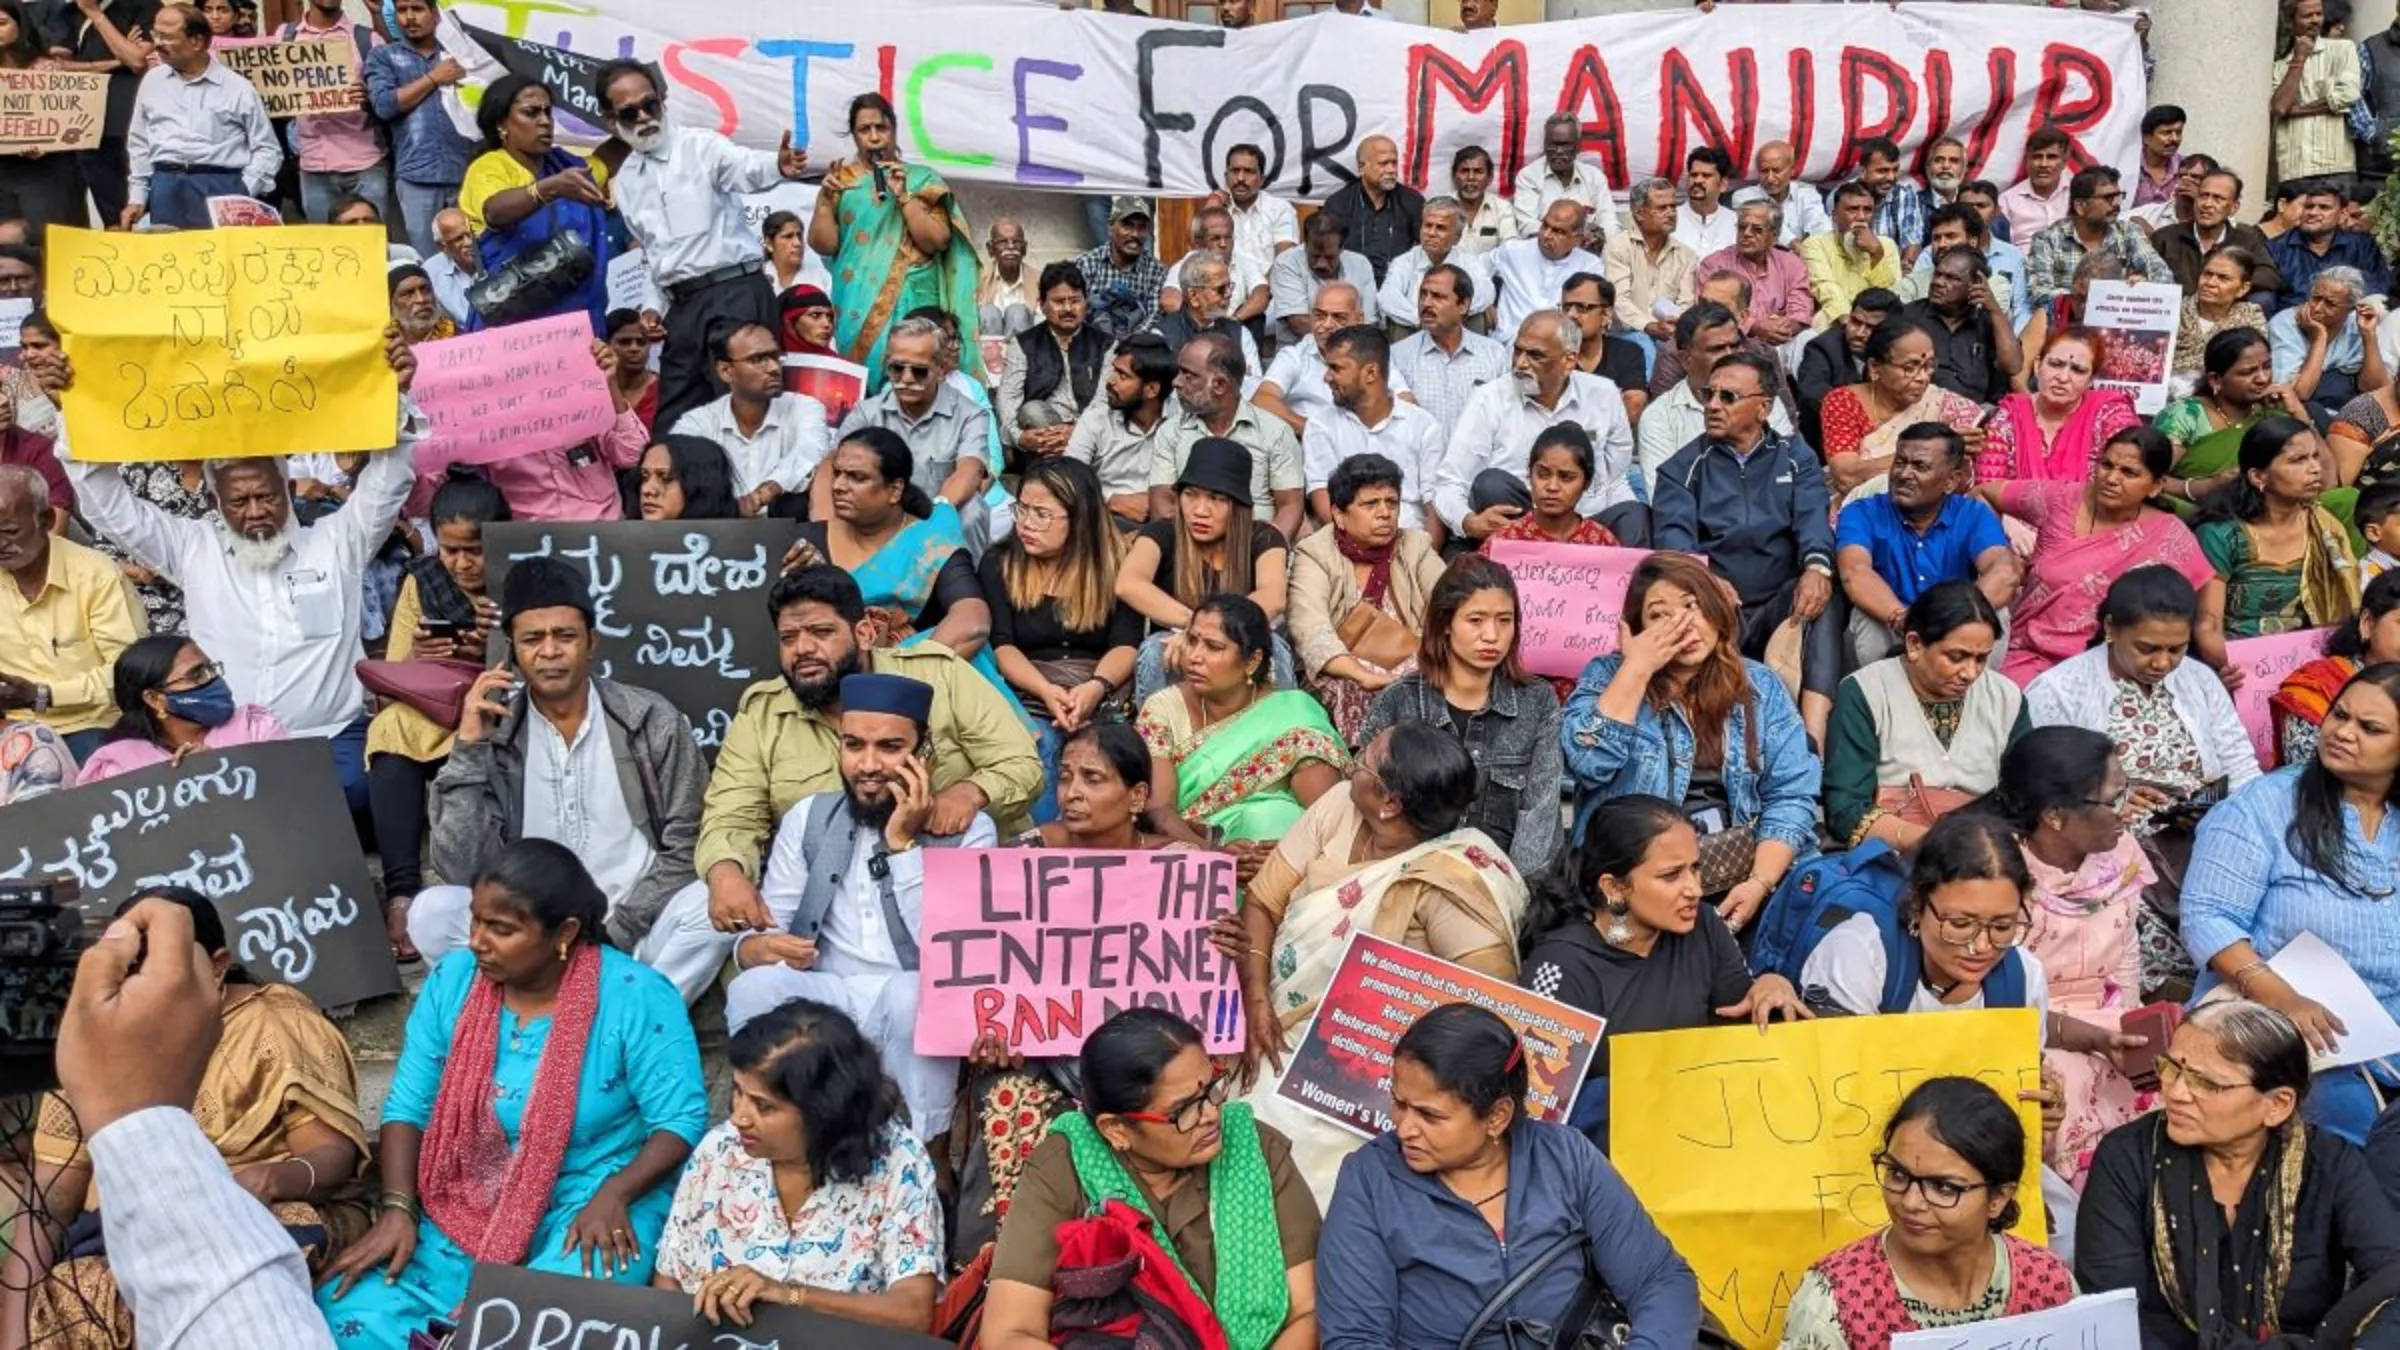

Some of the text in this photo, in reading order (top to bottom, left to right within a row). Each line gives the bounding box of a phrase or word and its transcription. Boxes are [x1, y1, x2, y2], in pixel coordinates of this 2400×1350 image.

[49, 74, 99, 91] BODIES
[220, 43, 327, 68] THERE CAN
[262, 69, 289, 88] NO
[293, 65, 348, 88] PEACE
[4, 93, 83, 111] NOT YOUR
[306, 91, 352, 109] JUSTIC
[542, 63, 603, 117] Man
[1137, 29, 1359, 193] FOR
[1402, 39, 2112, 197] MANIPUR
[168, 287, 302, 360] ನ್ಯಾಯ
[650, 532, 767, 596] ದೇಹ
[636, 616, 751, 679] ನಿಮ್ಮ
[979, 853, 1233, 924] LIFT THE
[235, 884, 359, 983] ನ್ಯಾಯ
[1360, 975, 1410, 1002] promotes
[1360, 950, 1377, 966] We
[1378, 956, 1422, 982] demand
[1421, 972, 1447, 991] that
[1446, 980, 1464, 997] the
[1465, 987, 1495, 1011] State
[1497, 1001, 1561, 1033] safeguards
[1562, 1024, 1585, 1043] and
[973, 988, 1083, 1047] BAN
[1332, 1008, 1389, 1041] Restorative
[1301, 1079, 1371, 1123] Women's
[1374, 1109, 1397, 1133] Vo
[1811, 1172, 1891, 1241] FO
